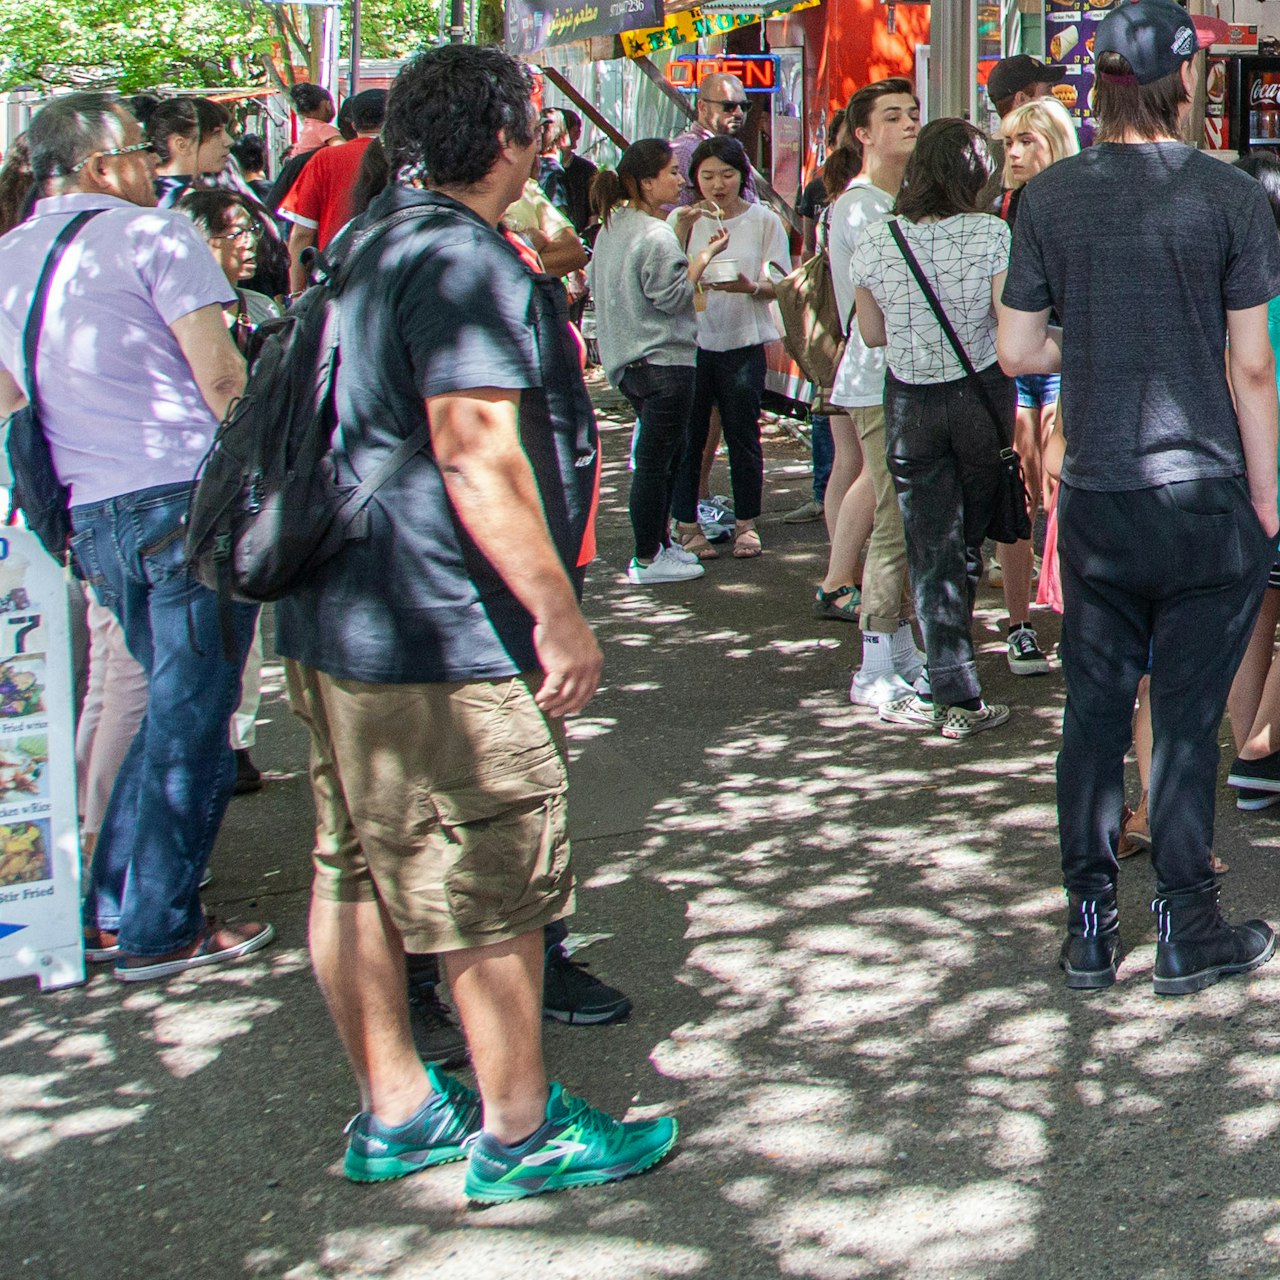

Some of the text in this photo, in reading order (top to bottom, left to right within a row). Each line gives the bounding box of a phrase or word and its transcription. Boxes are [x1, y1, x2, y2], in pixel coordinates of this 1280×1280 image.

[647, 26, 686, 51] EL
[666, 60, 773, 87] OPEN
[23, 886, 54, 901] Fried
